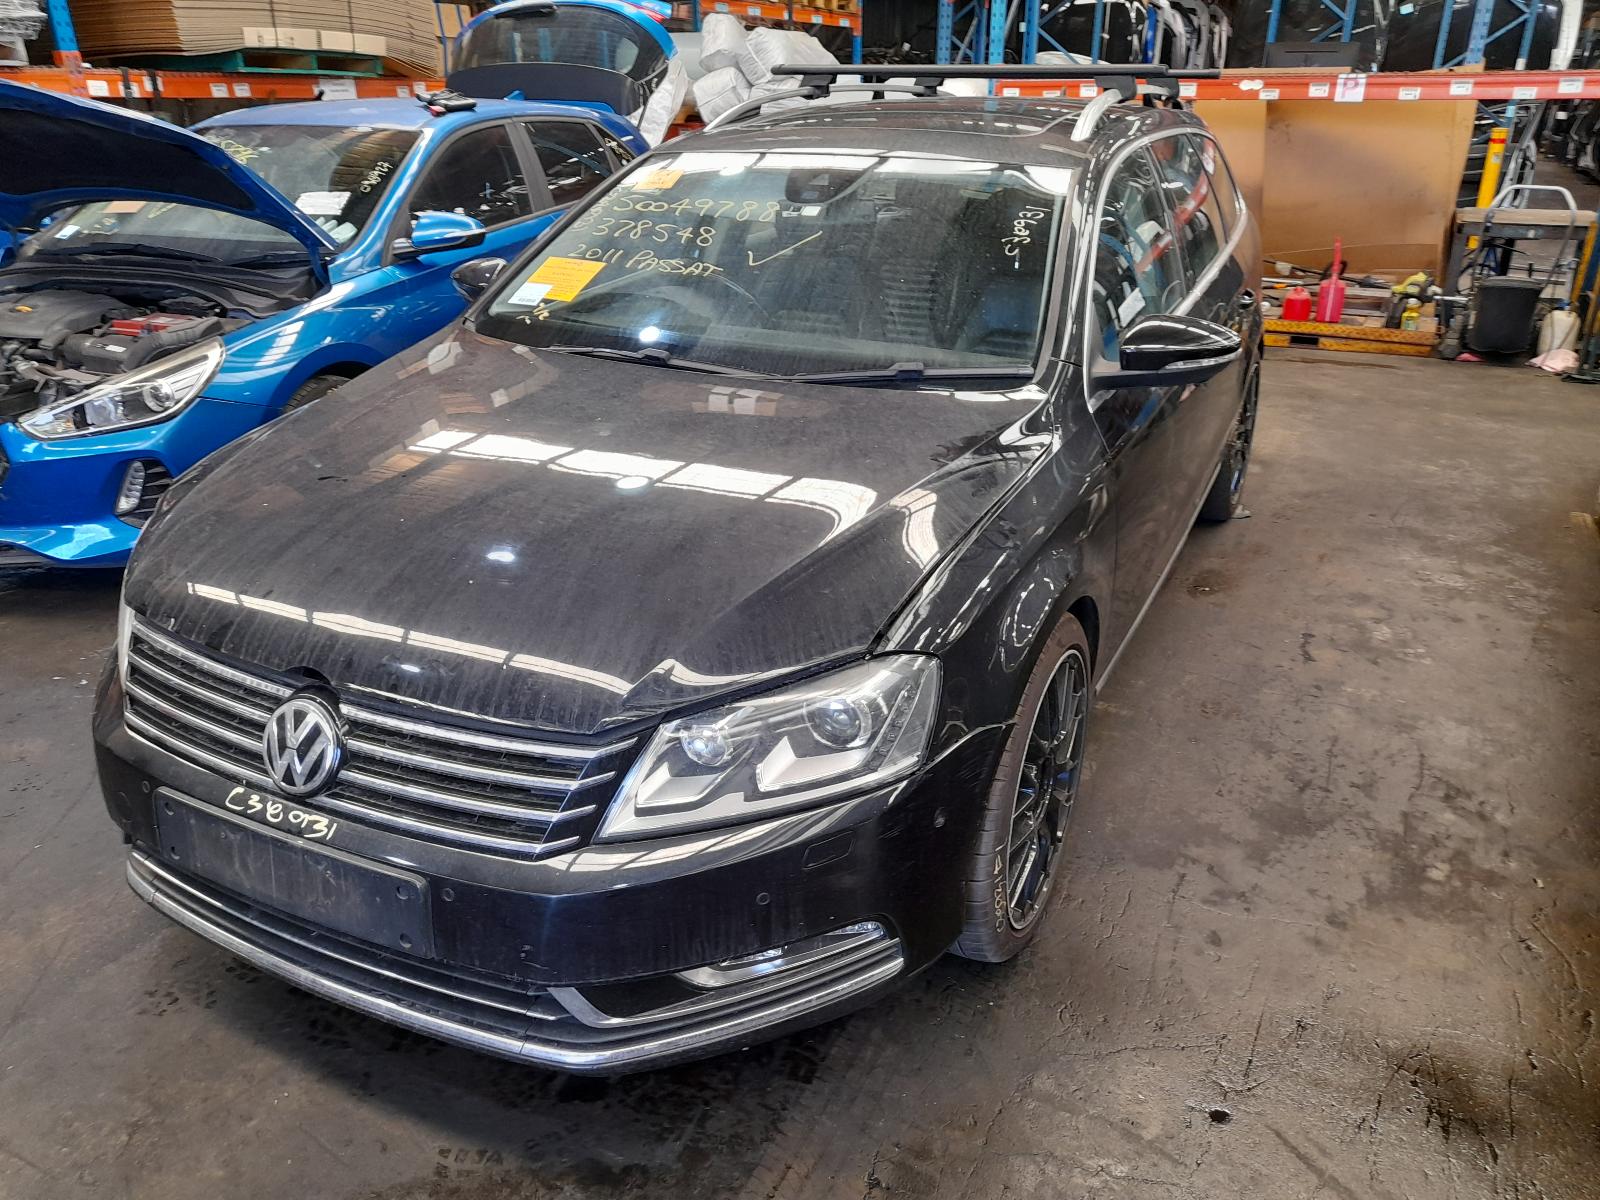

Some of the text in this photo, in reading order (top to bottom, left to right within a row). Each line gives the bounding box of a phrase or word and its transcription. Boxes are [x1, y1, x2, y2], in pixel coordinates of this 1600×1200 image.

[612, 194, 781, 222] 50049788
[592, 217, 717, 247] 378548
[567, 243, 724, 277] 2011 PASSAT
